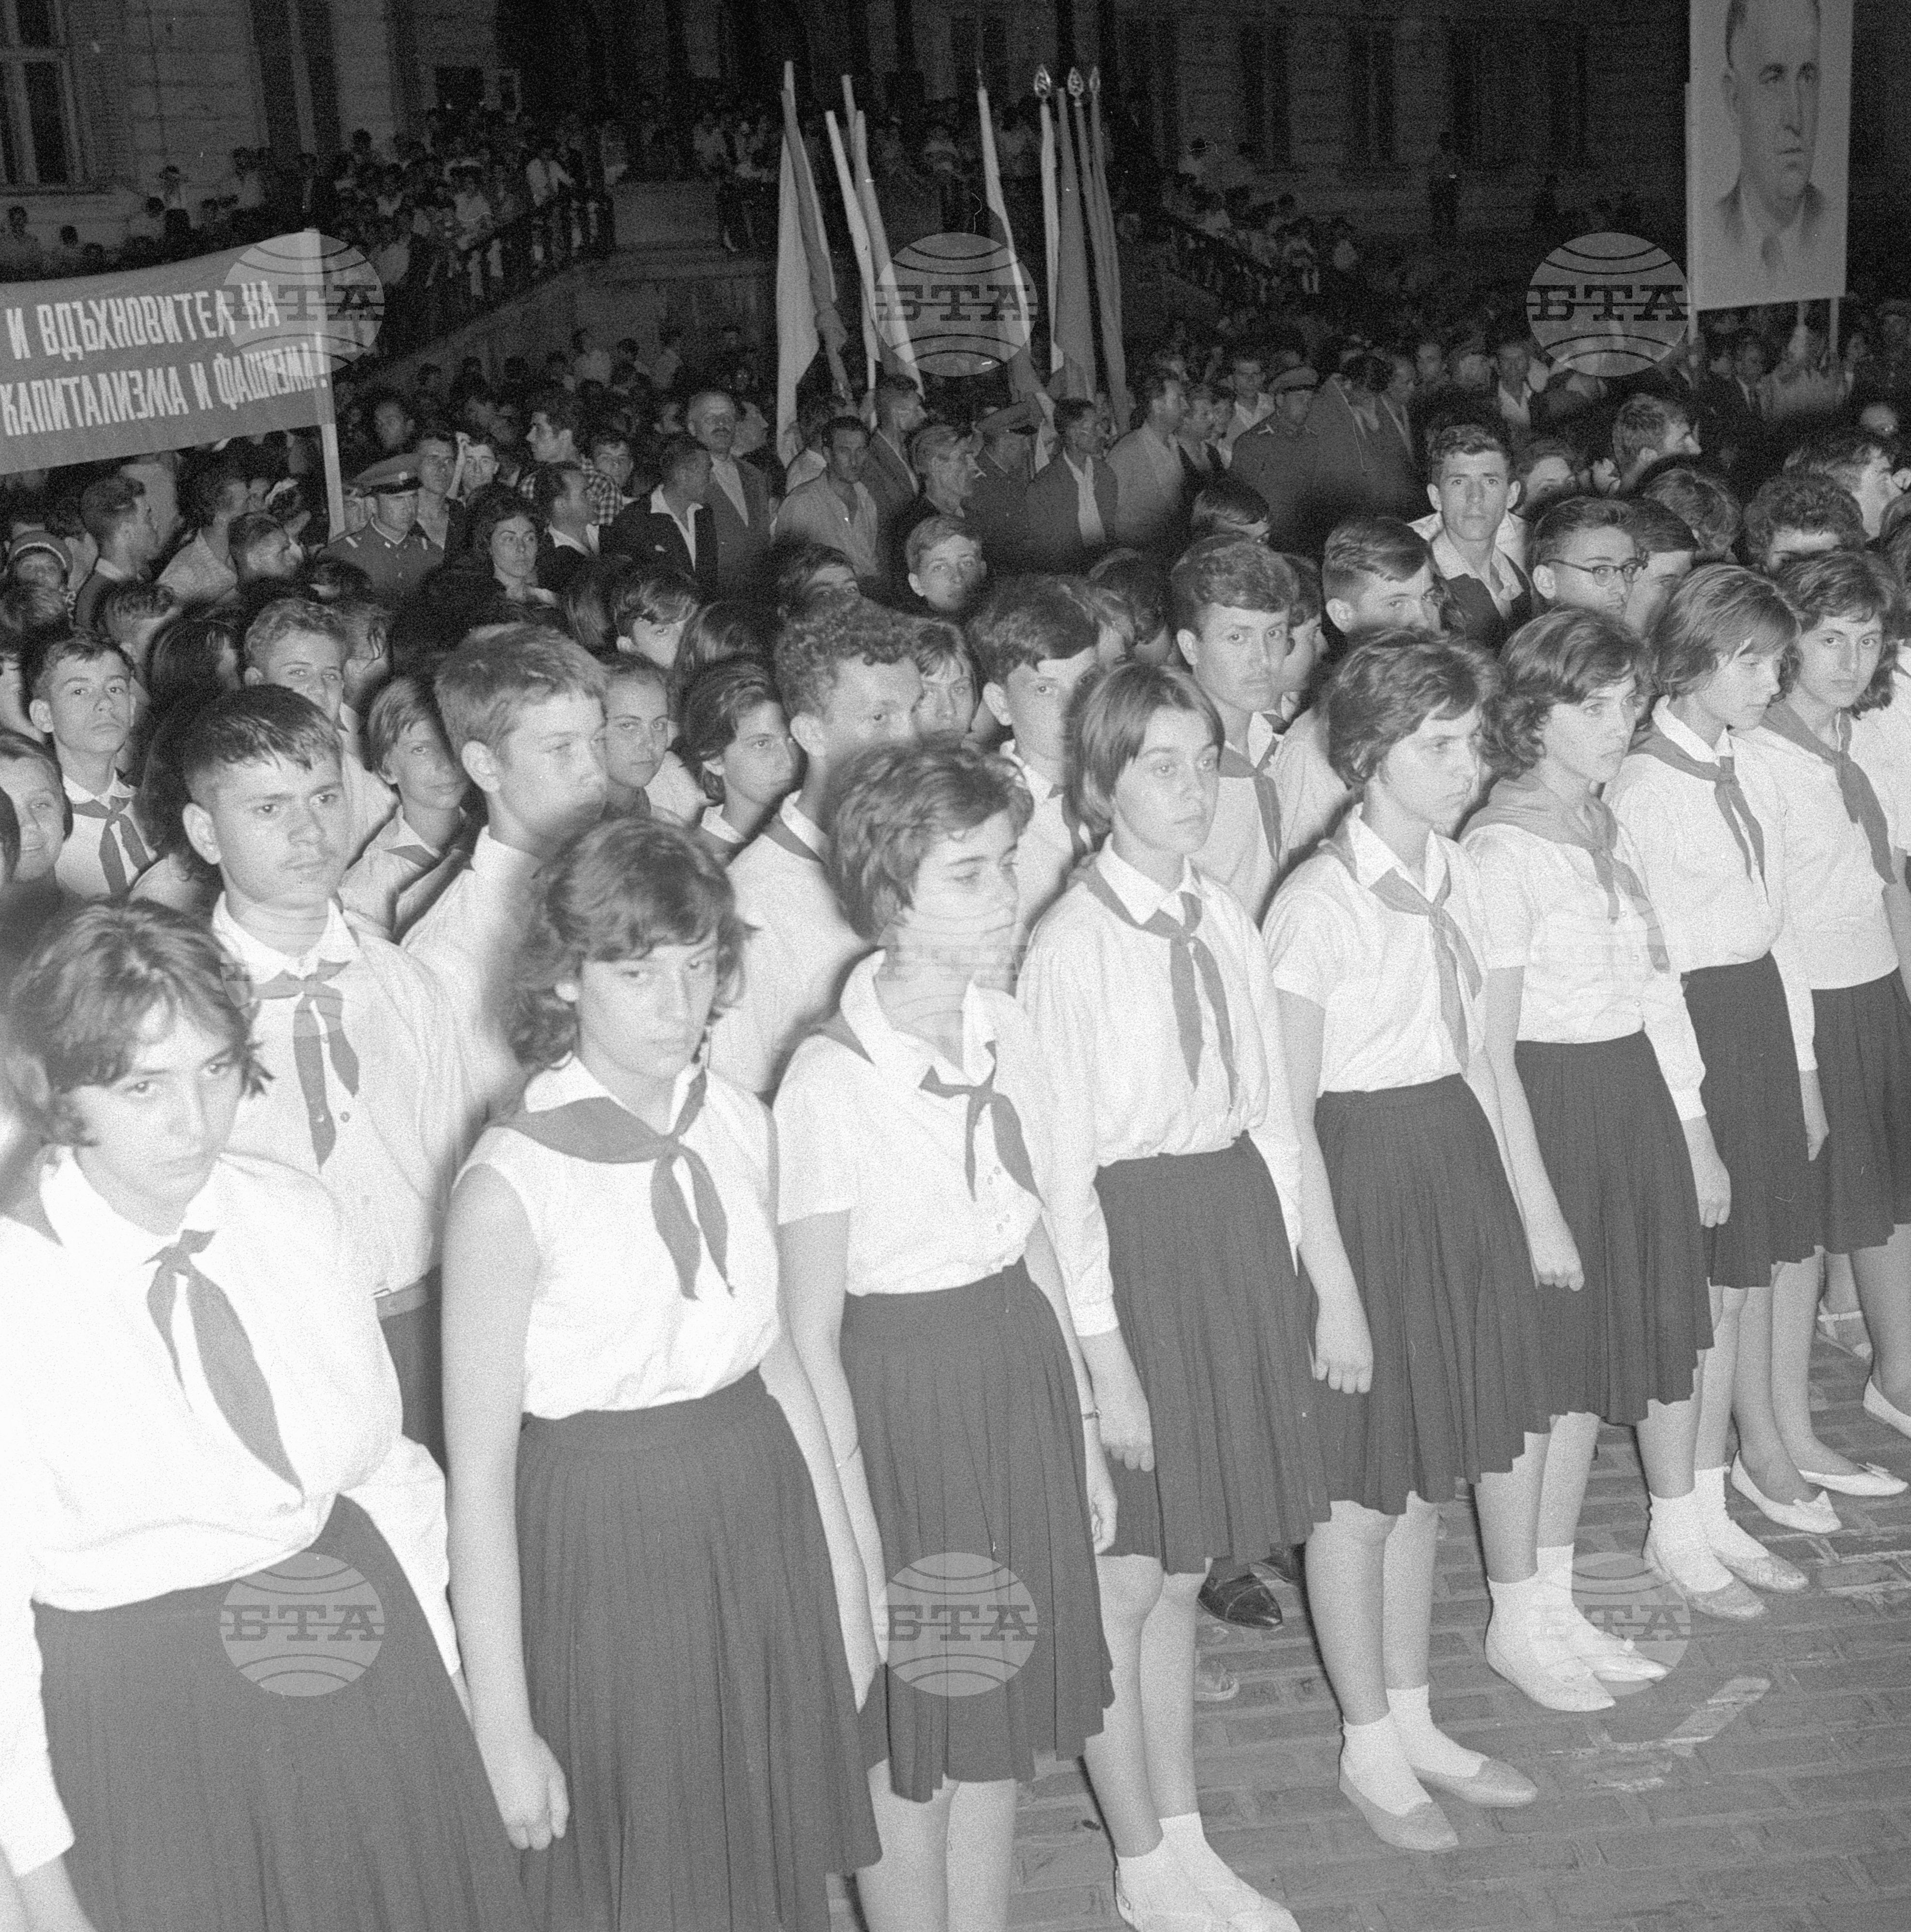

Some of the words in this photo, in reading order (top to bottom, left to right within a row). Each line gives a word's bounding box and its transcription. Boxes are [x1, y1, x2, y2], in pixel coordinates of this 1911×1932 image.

[5, 308, 31, 360] И
[37, 289, 236, 361] ВДЪХНОВИТЕЛ
[241, 279, 281, 330] НА
[0, 366, 189, 436] КАПИТАЛИЗМА
[190, 362, 214, 411] И
